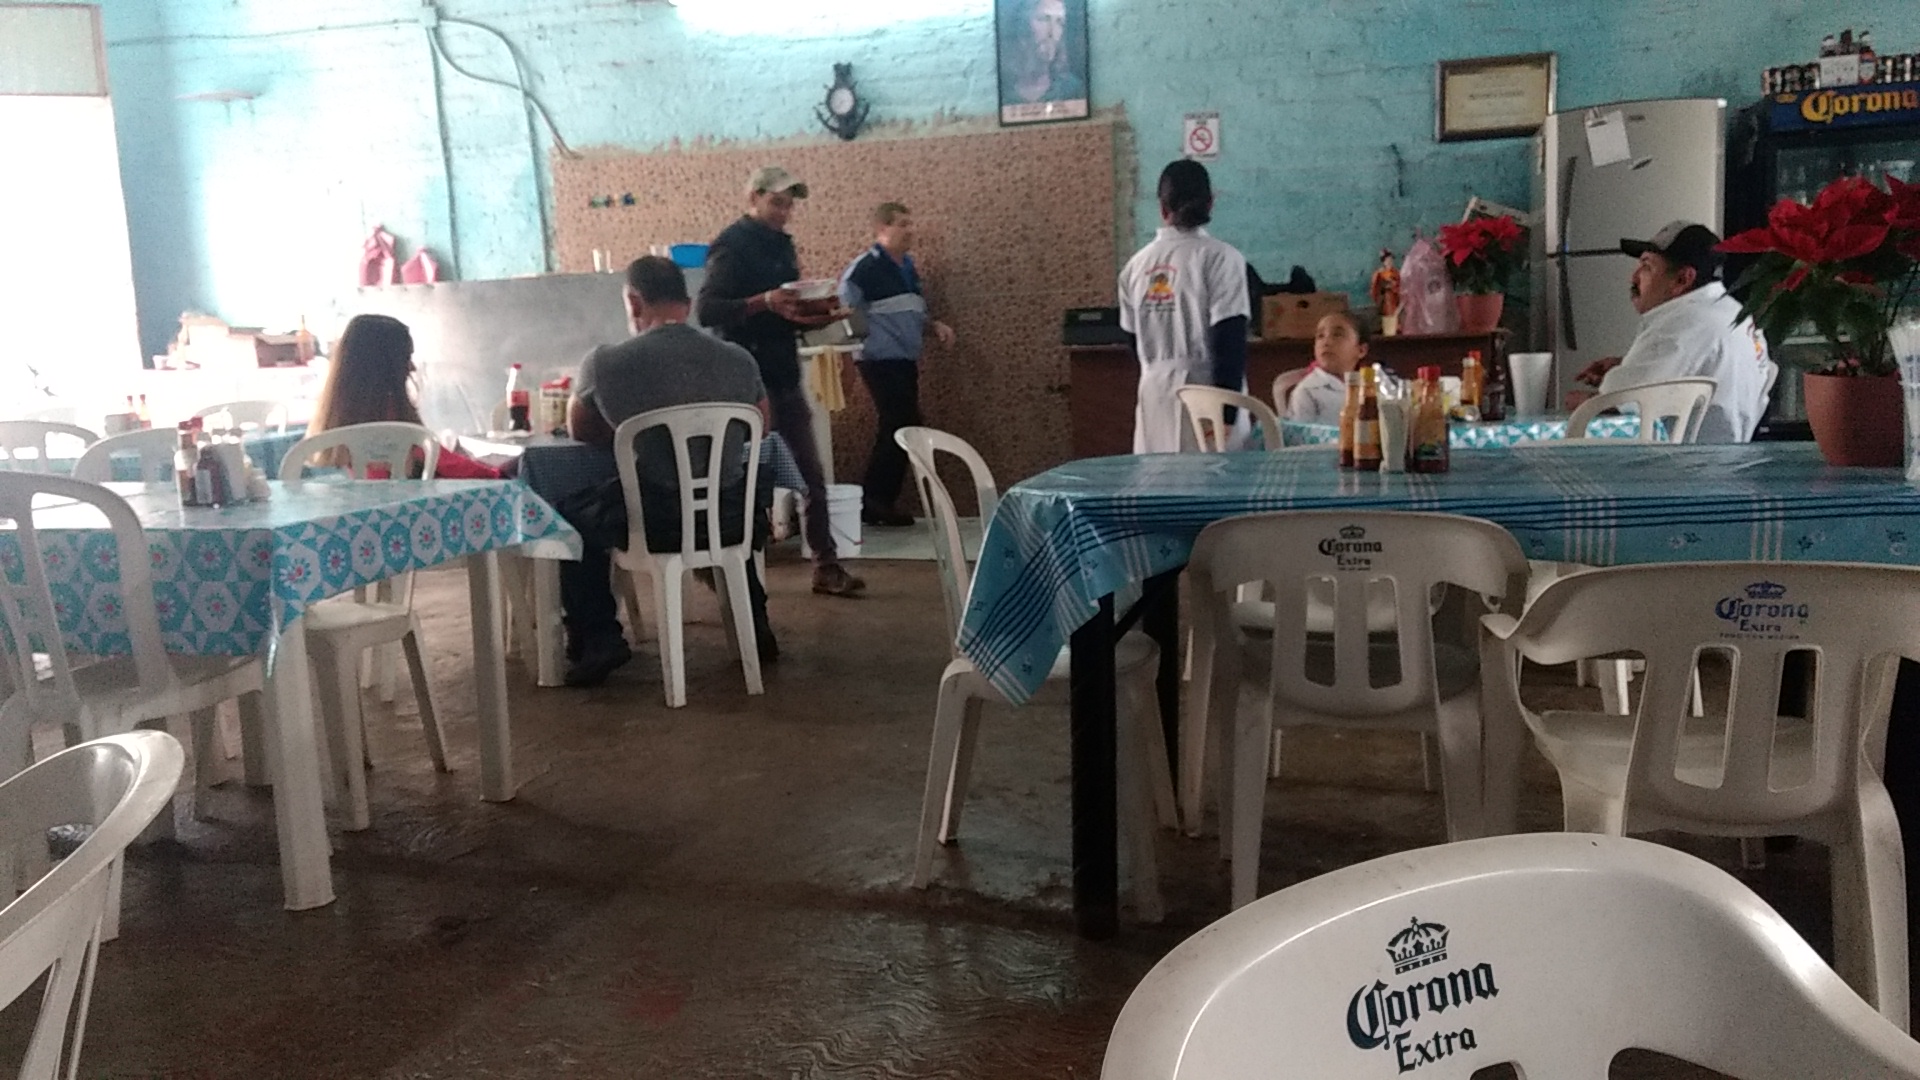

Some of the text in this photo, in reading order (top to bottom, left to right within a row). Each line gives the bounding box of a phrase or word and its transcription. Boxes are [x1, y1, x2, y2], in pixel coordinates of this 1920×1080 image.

[1801, 90, 1918, 123] Corona
[1318, 539, 1383, 556] Corona
[1715, 597, 1809, 622] Corona
[1739, 619, 1782, 632] Extra
[1347, 962, 1500, 1051] Corona
[1393, 1027, 1478, 1075] Extra
